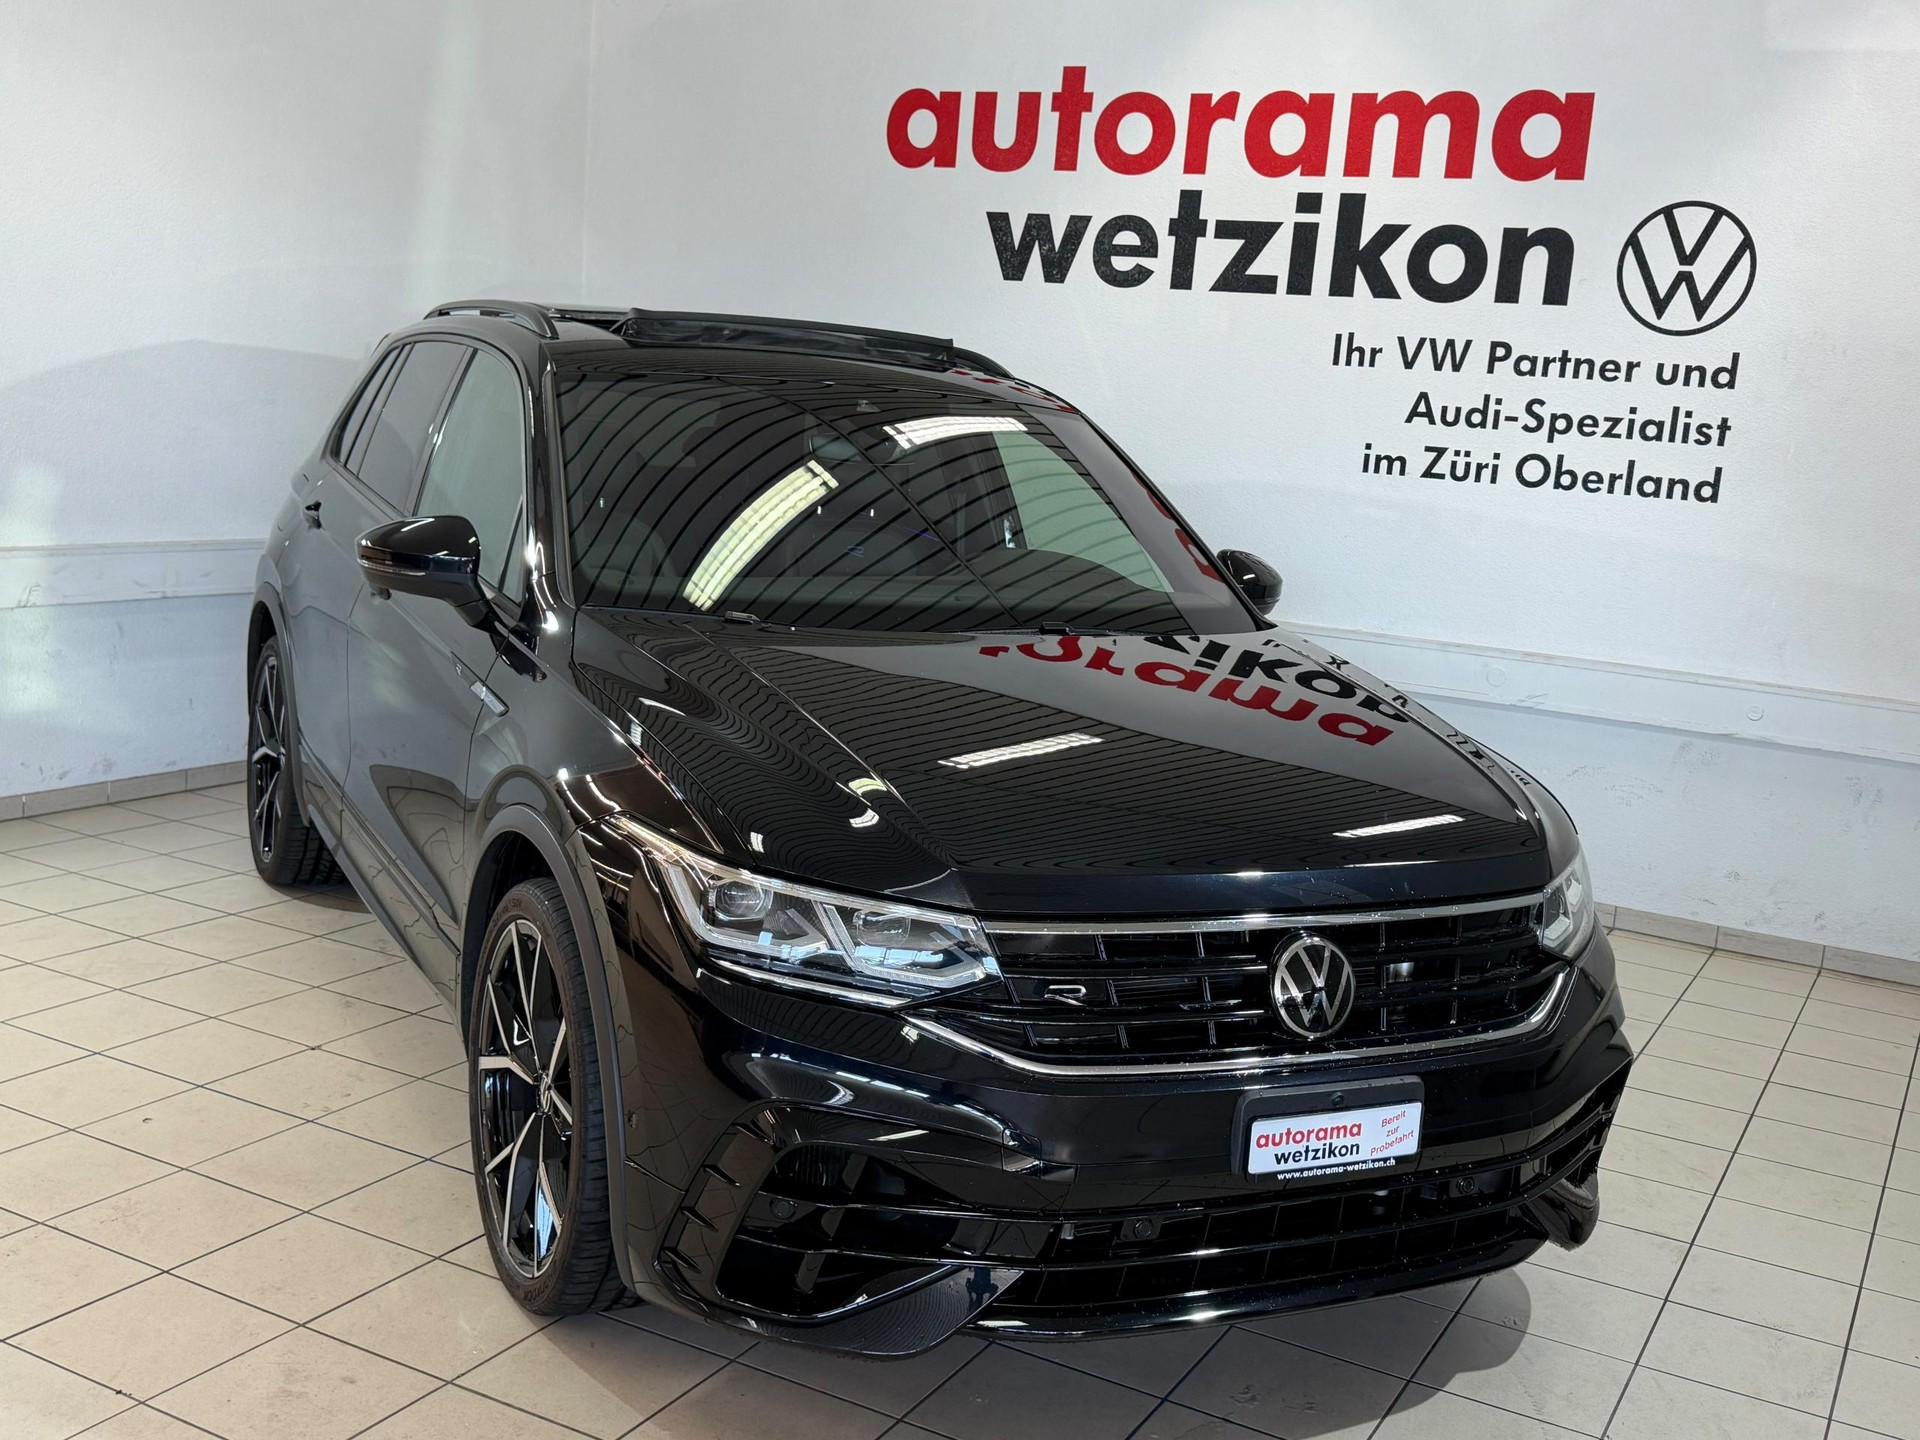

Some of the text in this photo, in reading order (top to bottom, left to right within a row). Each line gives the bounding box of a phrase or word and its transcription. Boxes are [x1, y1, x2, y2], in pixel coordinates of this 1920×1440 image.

[886, 65, 1596, 182] autorama
[985, 189, 1575, 306] wetzikon
[1617, 200, 1757, 337] VW
[1332, 332, 1741, 390] Ihr VW Partner und
[1404, 391, 1733, 447] Audi-Spezialist
[1362, 442, 1724, 504] im Züri Oberland
[1256, 1124, 1362, 1149] autorama
[1381, 1109, 1406, 1128] Bereit
[1386, 1125, 1400, 1138] zur
[1274, 1142, 1360, 1165] wetzikon
[1370, 1130, 1414, 1157] Probefahrt
[1277, 1157, 1396, 1180] www.autorama-wetzikon.ch
